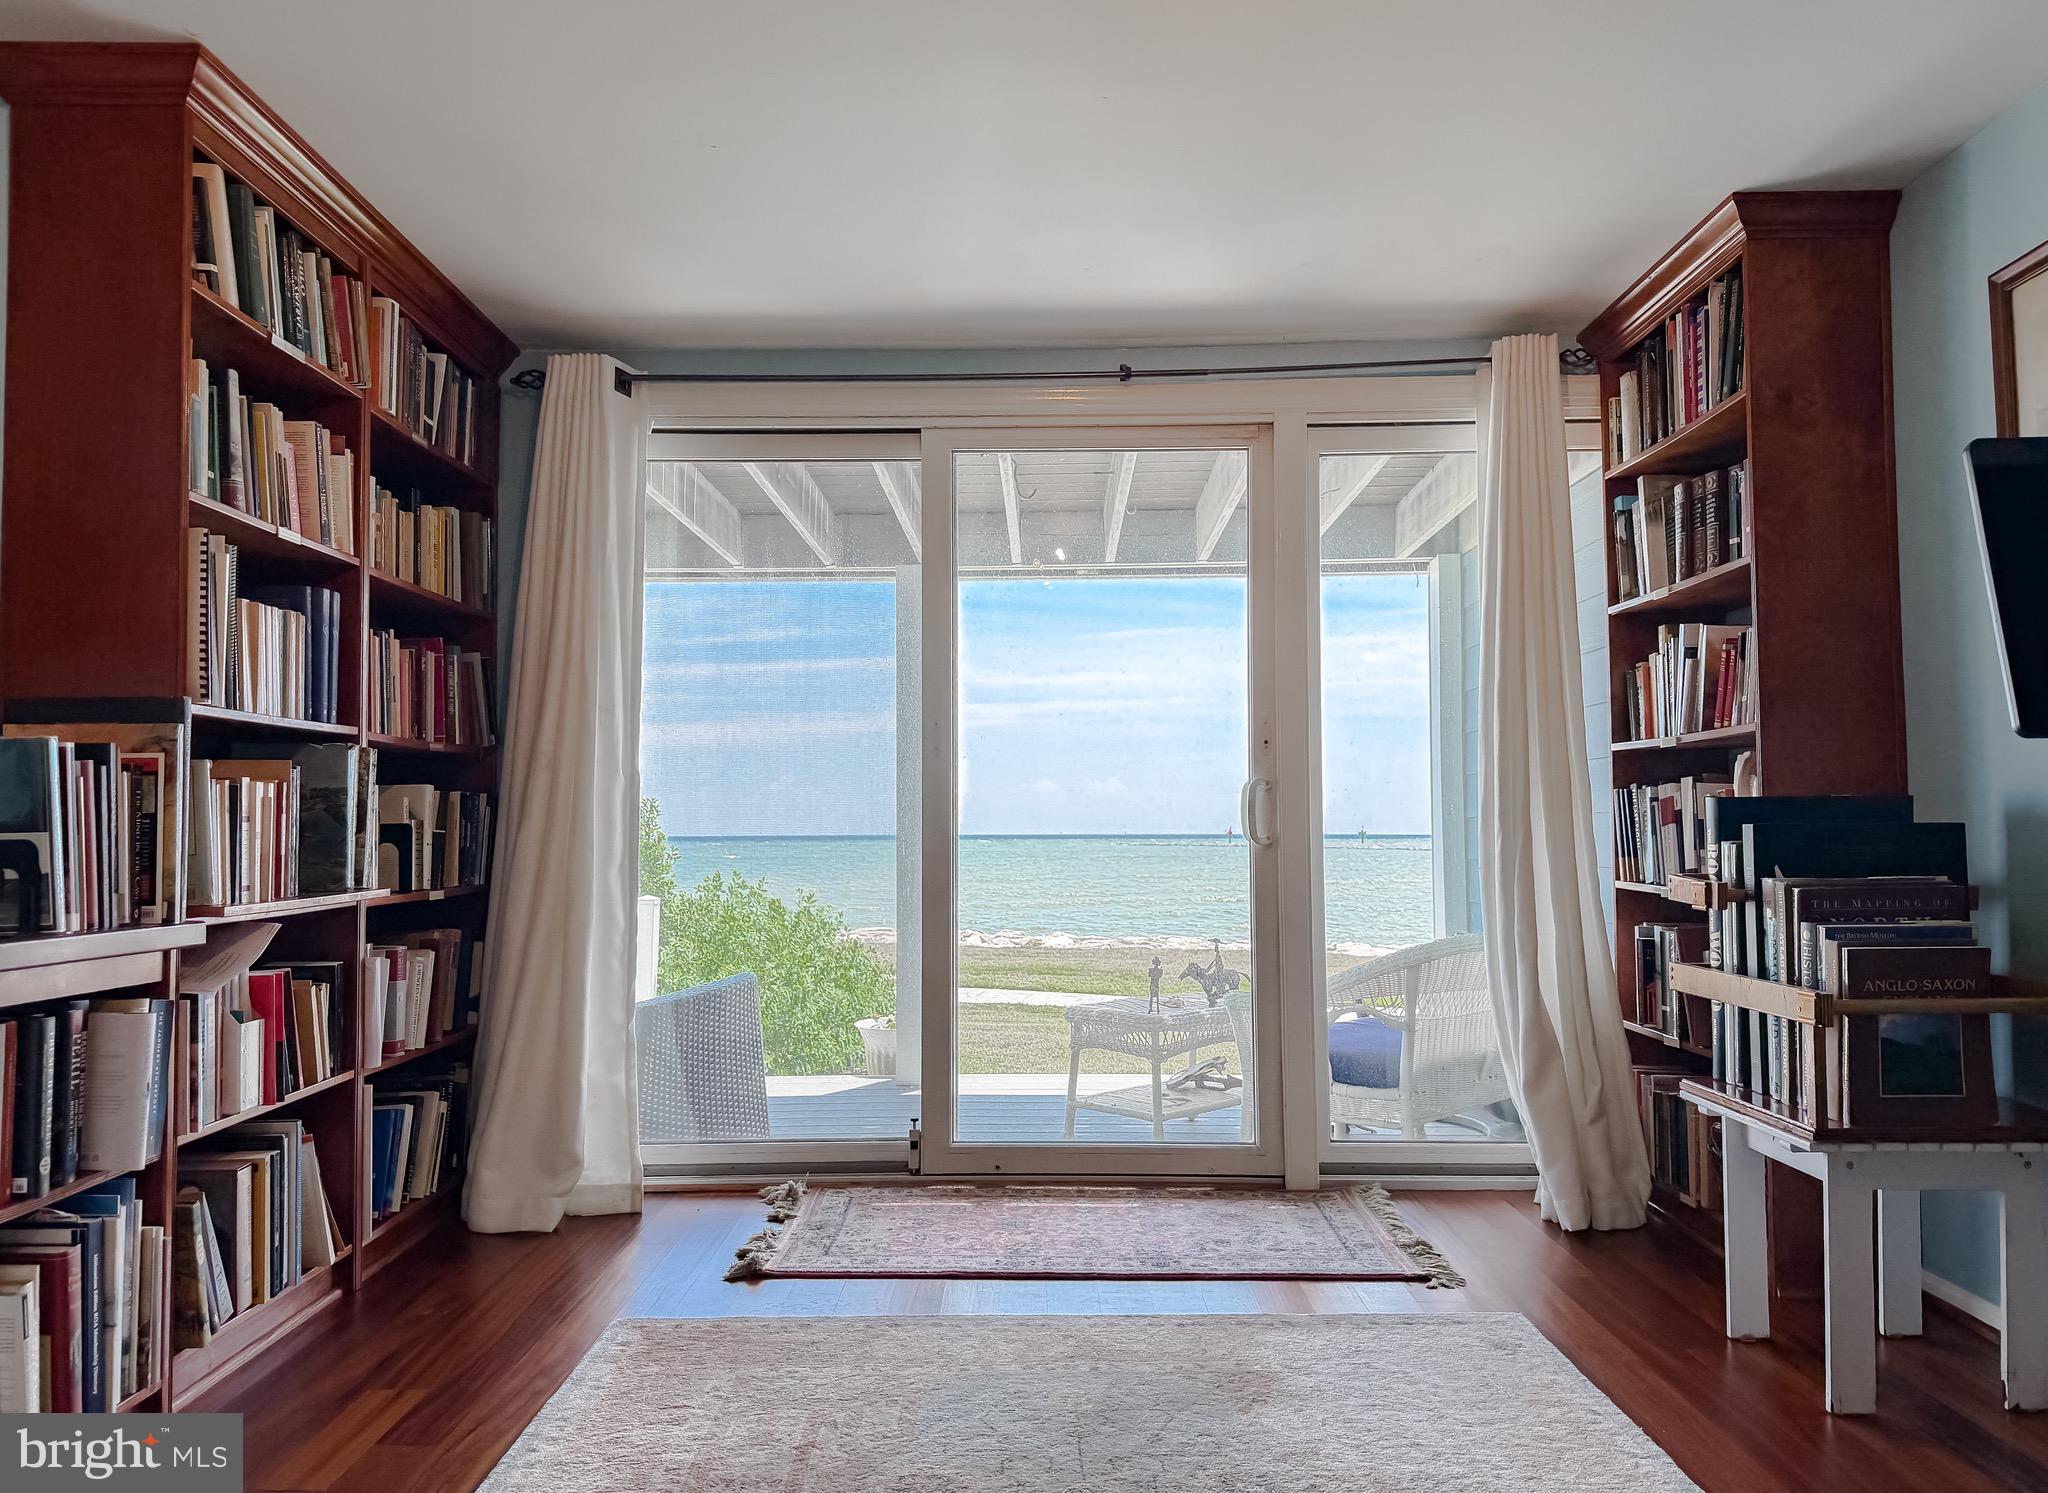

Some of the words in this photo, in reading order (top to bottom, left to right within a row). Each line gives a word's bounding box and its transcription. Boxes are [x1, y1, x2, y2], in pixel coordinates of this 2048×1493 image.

[1810, 899, 1842, 909] THE
[1850, 899, 1923, 909] MAPPING
[1932, 899, 1952, 908] OF
[1834, 932, 1845, 940] THE
[1846, 932, 1869, 940] BRITISH
[1870, 931, 1898, 940] MUSEUM
[70, 1033, 81, 1090] PERIL
[45, 1080, 54, 1149] REVEALED
